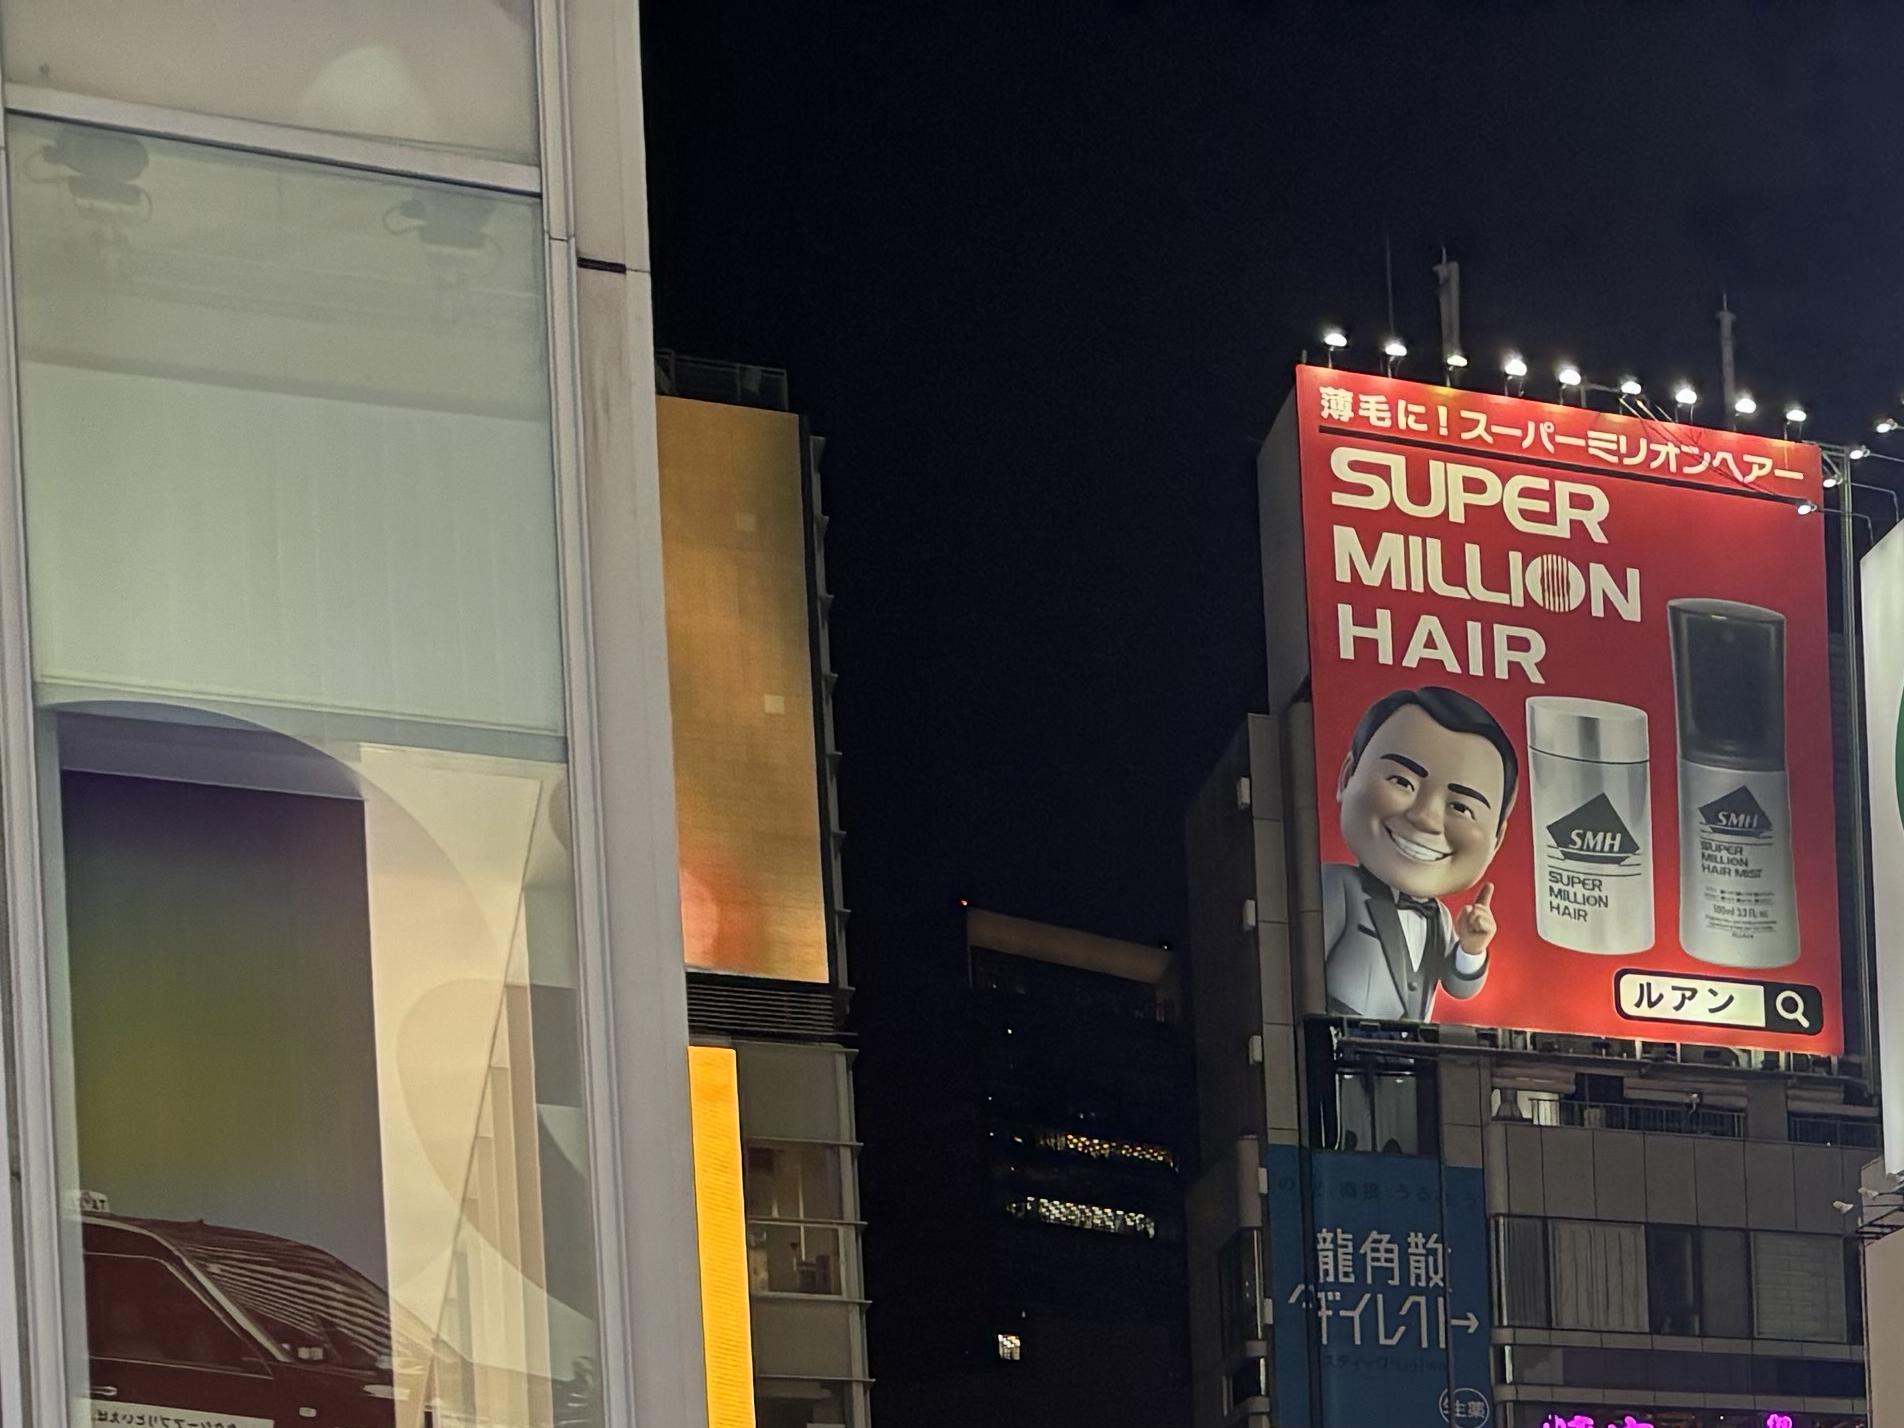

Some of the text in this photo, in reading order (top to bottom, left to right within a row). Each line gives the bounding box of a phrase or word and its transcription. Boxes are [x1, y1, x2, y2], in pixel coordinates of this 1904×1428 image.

[1330, 446, 1610, 545] SUPER
[1332, 524, 1643, 623] MILLION
[1335, 602, 1548, 686] HAIR
[1717, 810, 1760, 829] SMH
[1568, 828, 1622, 853] SMH
[1547, 871, 1604, 893] SUPER
[1548, 885, 1610, 909] MILLION
[1549, 902, 1589, 923] HAIR
[1633, 980, 1738, 1013] ルアン
[1316, 1226, 1446, 1288] 龍角散
